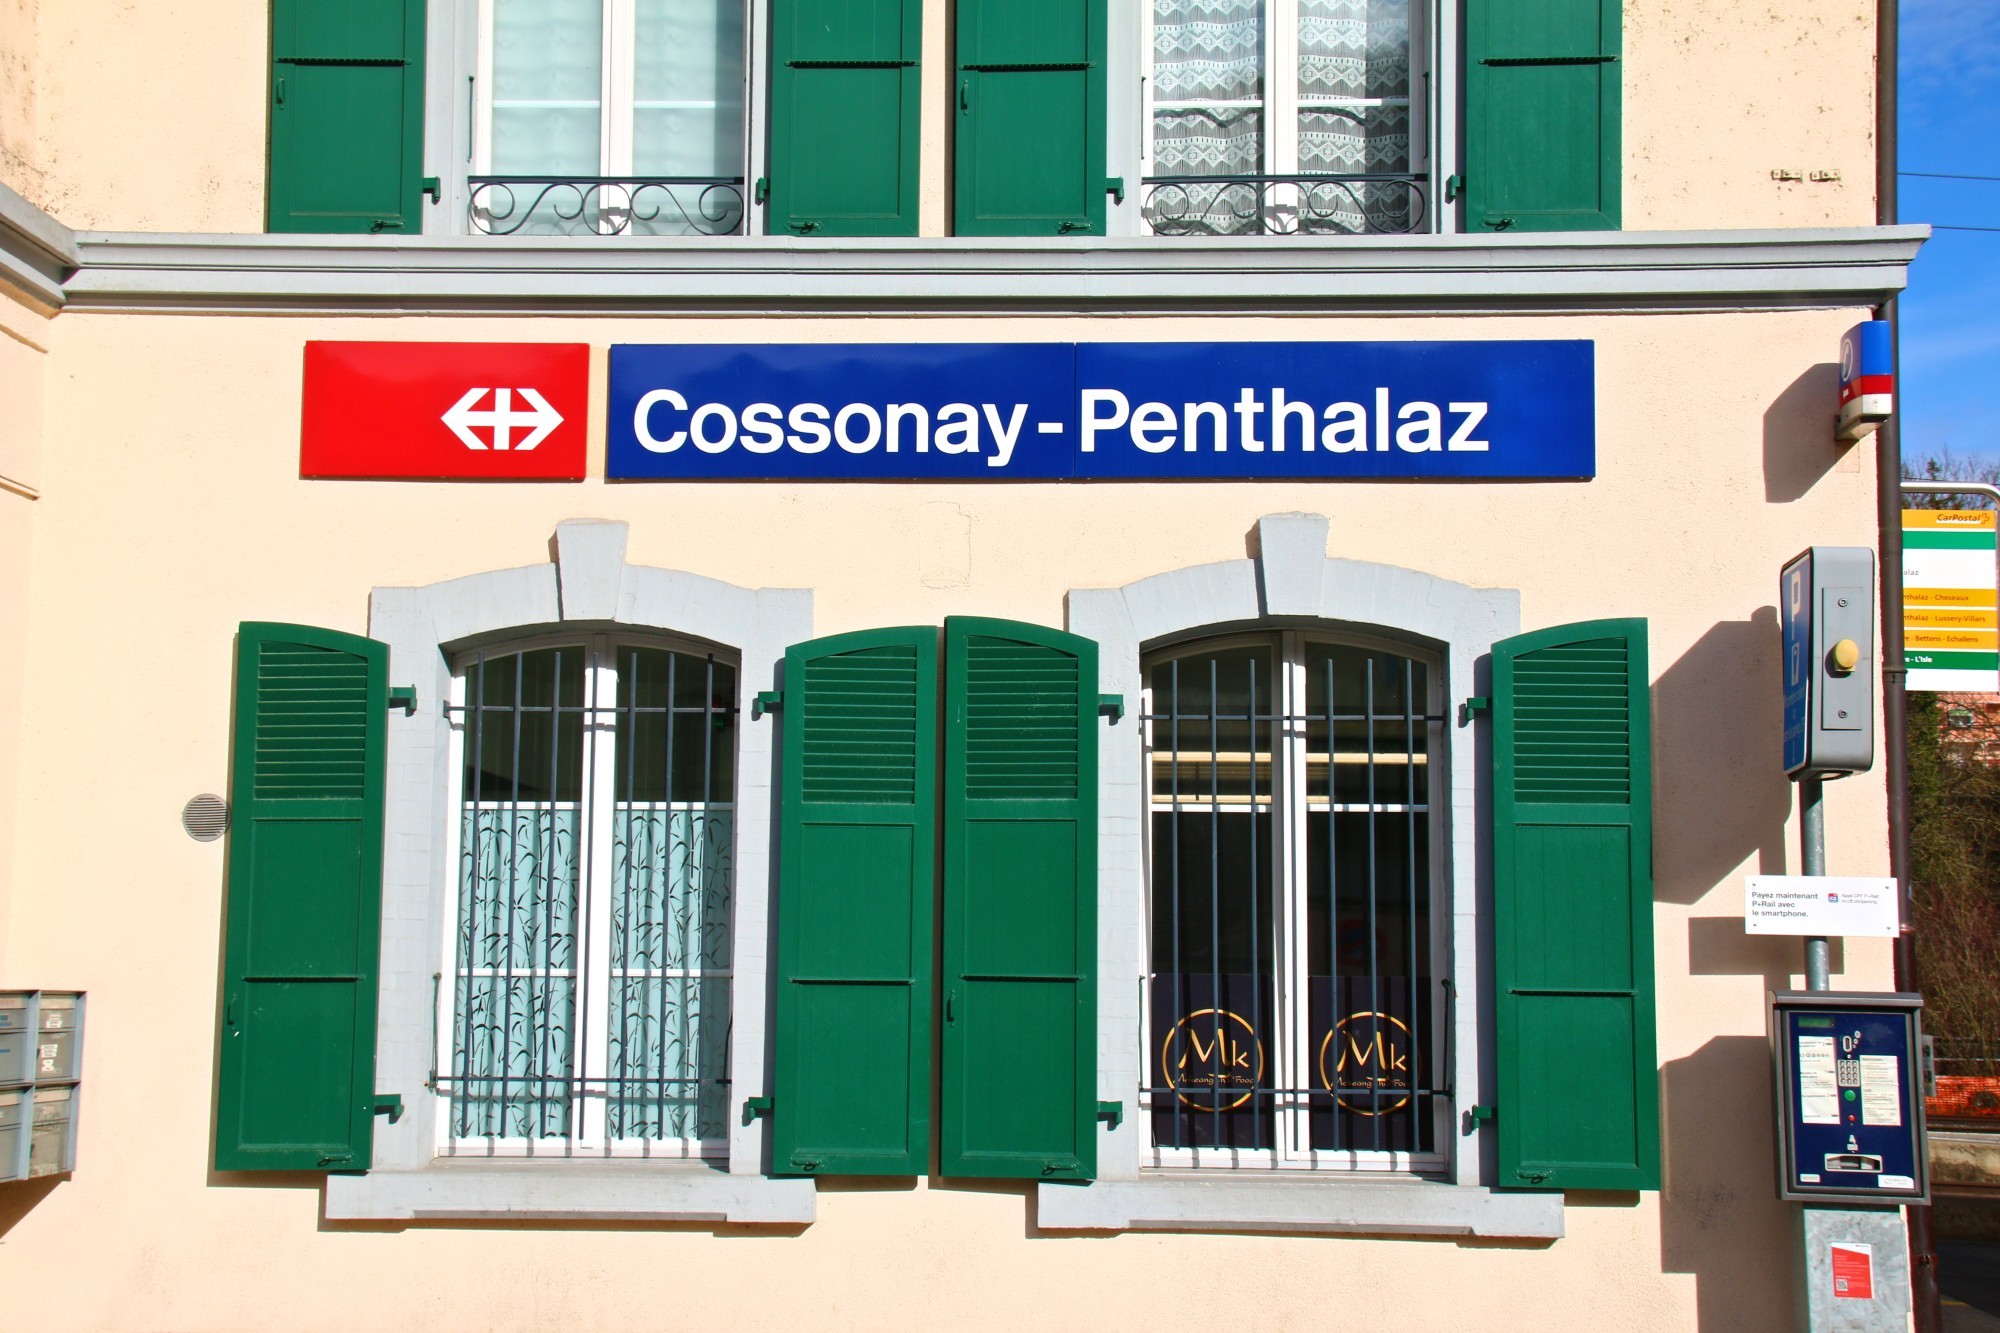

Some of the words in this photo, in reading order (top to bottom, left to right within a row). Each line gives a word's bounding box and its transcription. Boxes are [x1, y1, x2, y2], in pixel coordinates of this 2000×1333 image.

[1937, 513, 1981, 522] CarPostal
[1947, 635, 1979, 643] Echallens
[1752, 891, 1774, 900] Payez
[1775, 892, 1819, 900] maintenant
[1752, 900, 1776, 908] P+Rail
[1760, 910, 1809, 918] smartphone.
